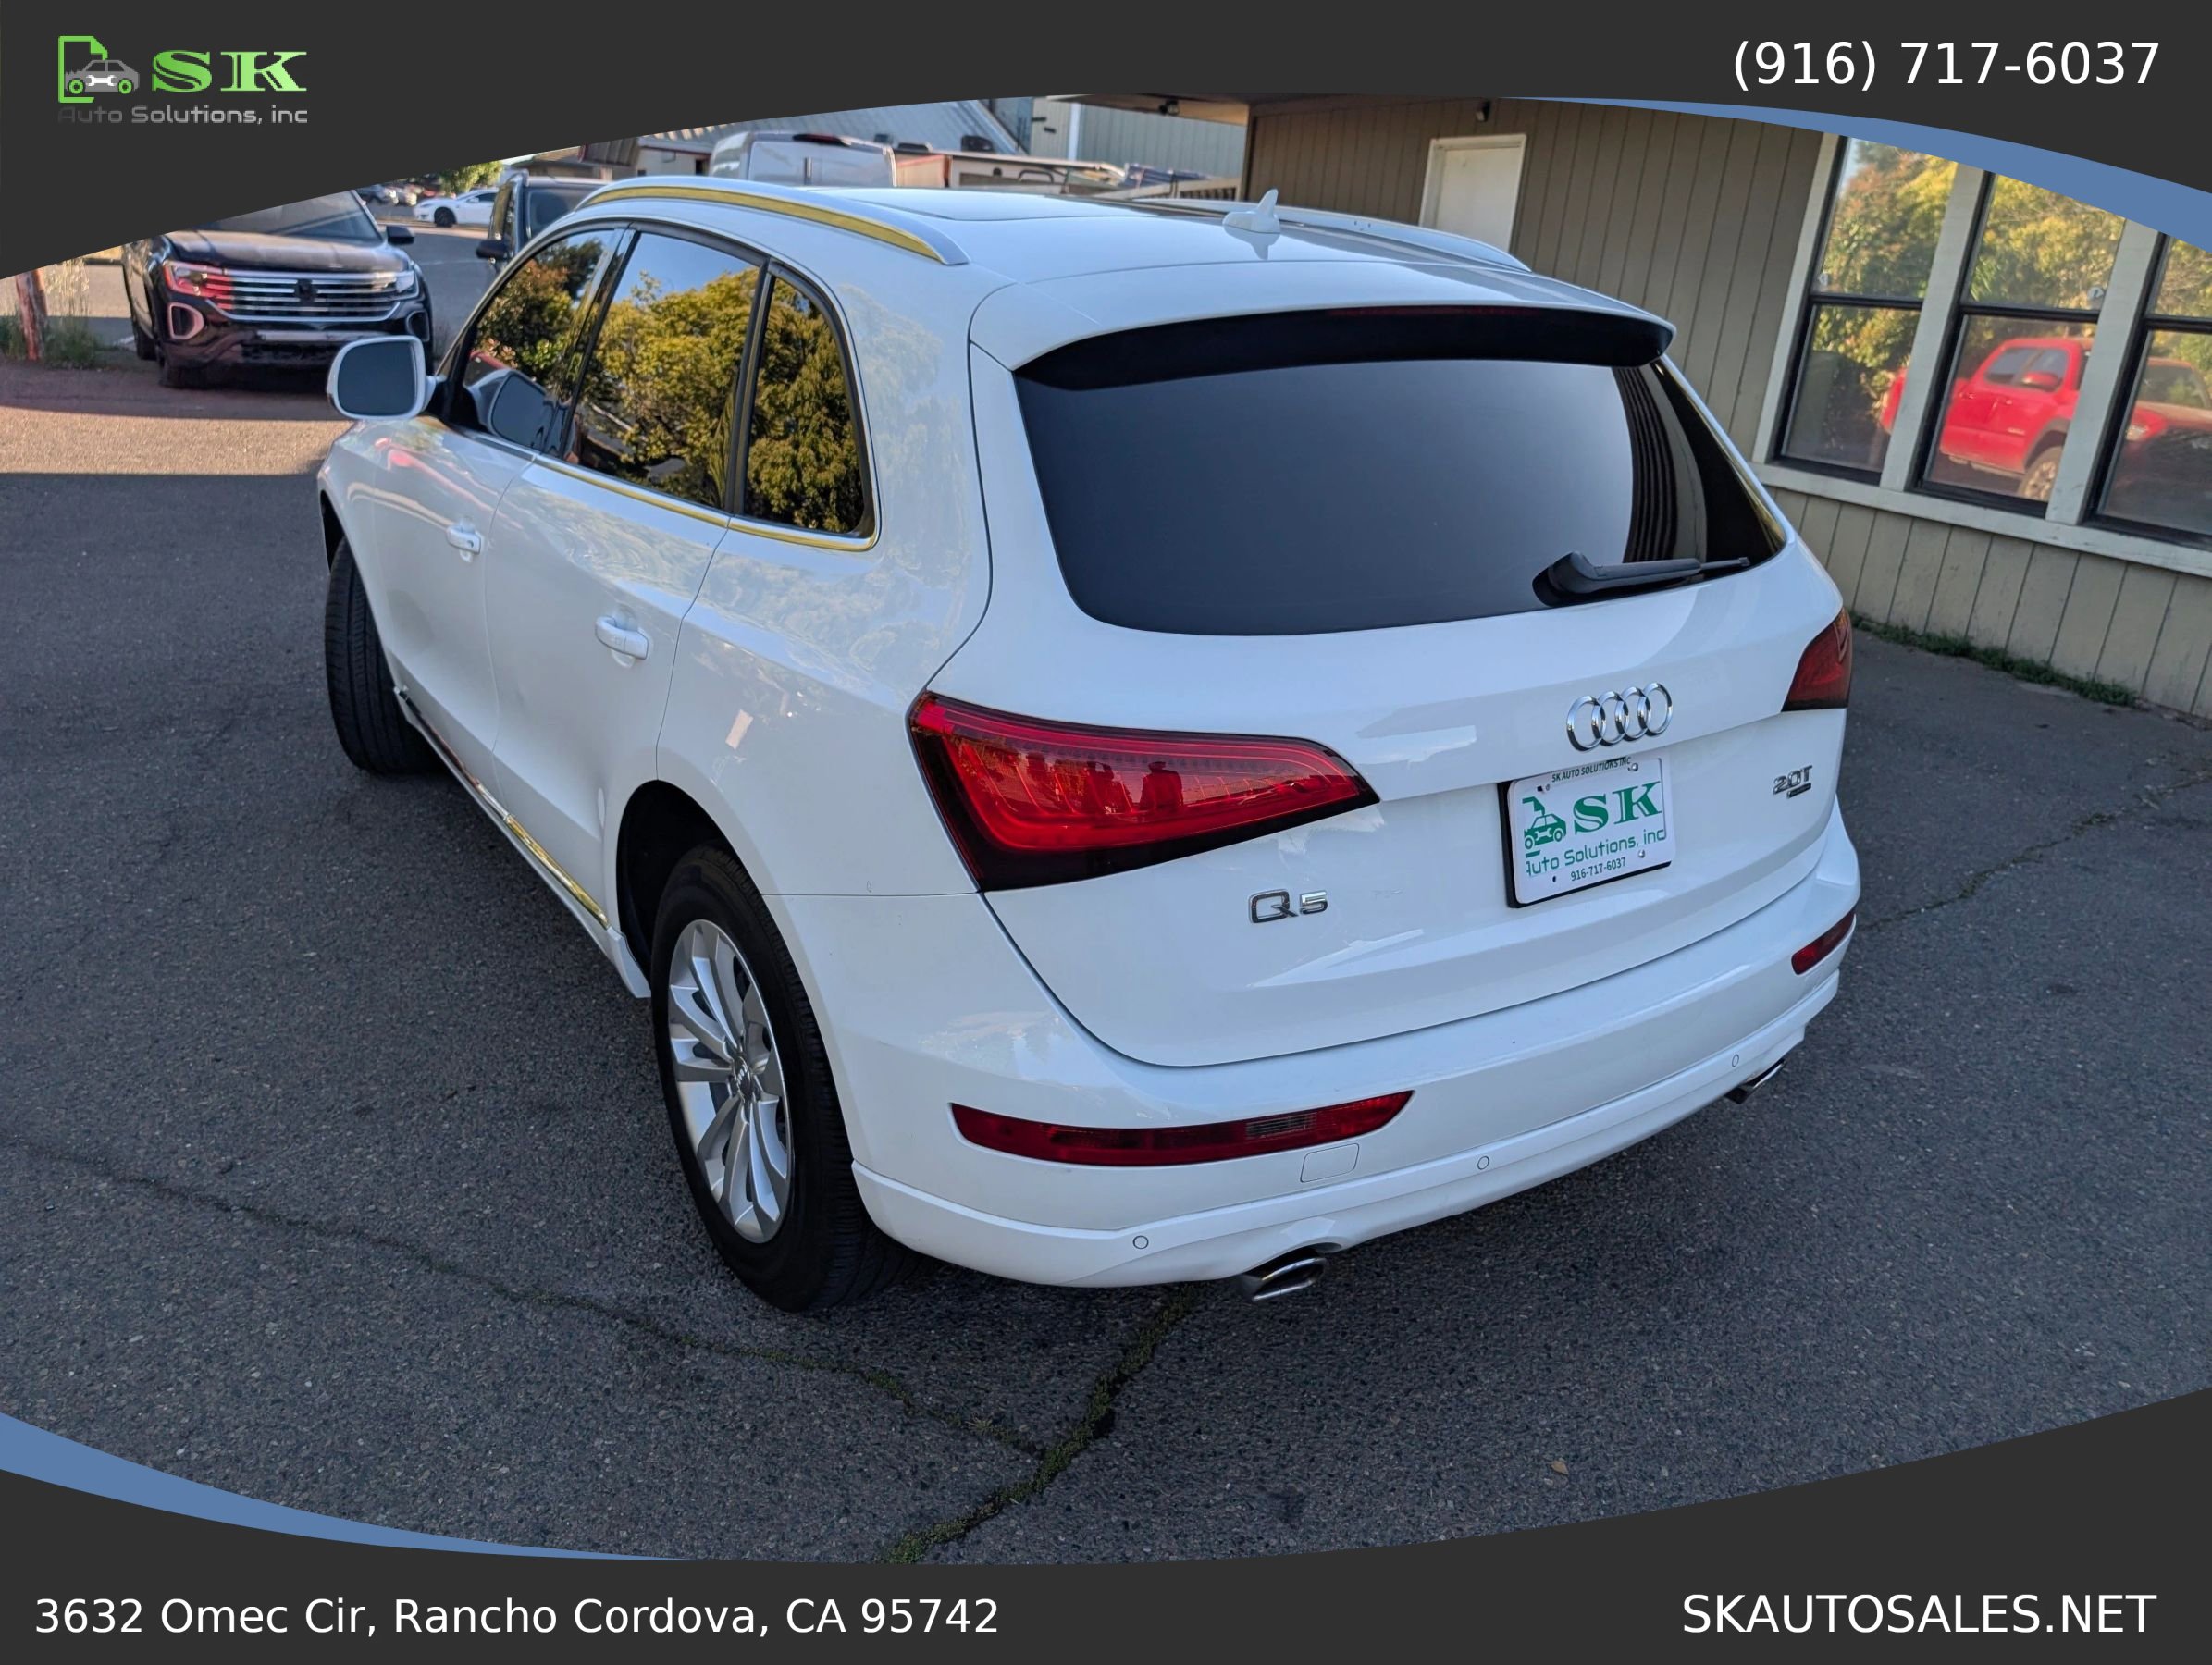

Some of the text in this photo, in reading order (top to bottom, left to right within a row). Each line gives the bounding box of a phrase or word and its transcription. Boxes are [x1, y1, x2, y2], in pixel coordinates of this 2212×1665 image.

[1551, 756, 1632, 783] SK AUTO SOLUTIONS INC
[1573, 781, 1662, 835] SK
[1564, 835, 1639, 866] Solutions,
[1643, 829, 1667, 845] inc
[1570, 857, 1626, 882] 916-717-6037
[1248, 888, 1328, 924] Q5
